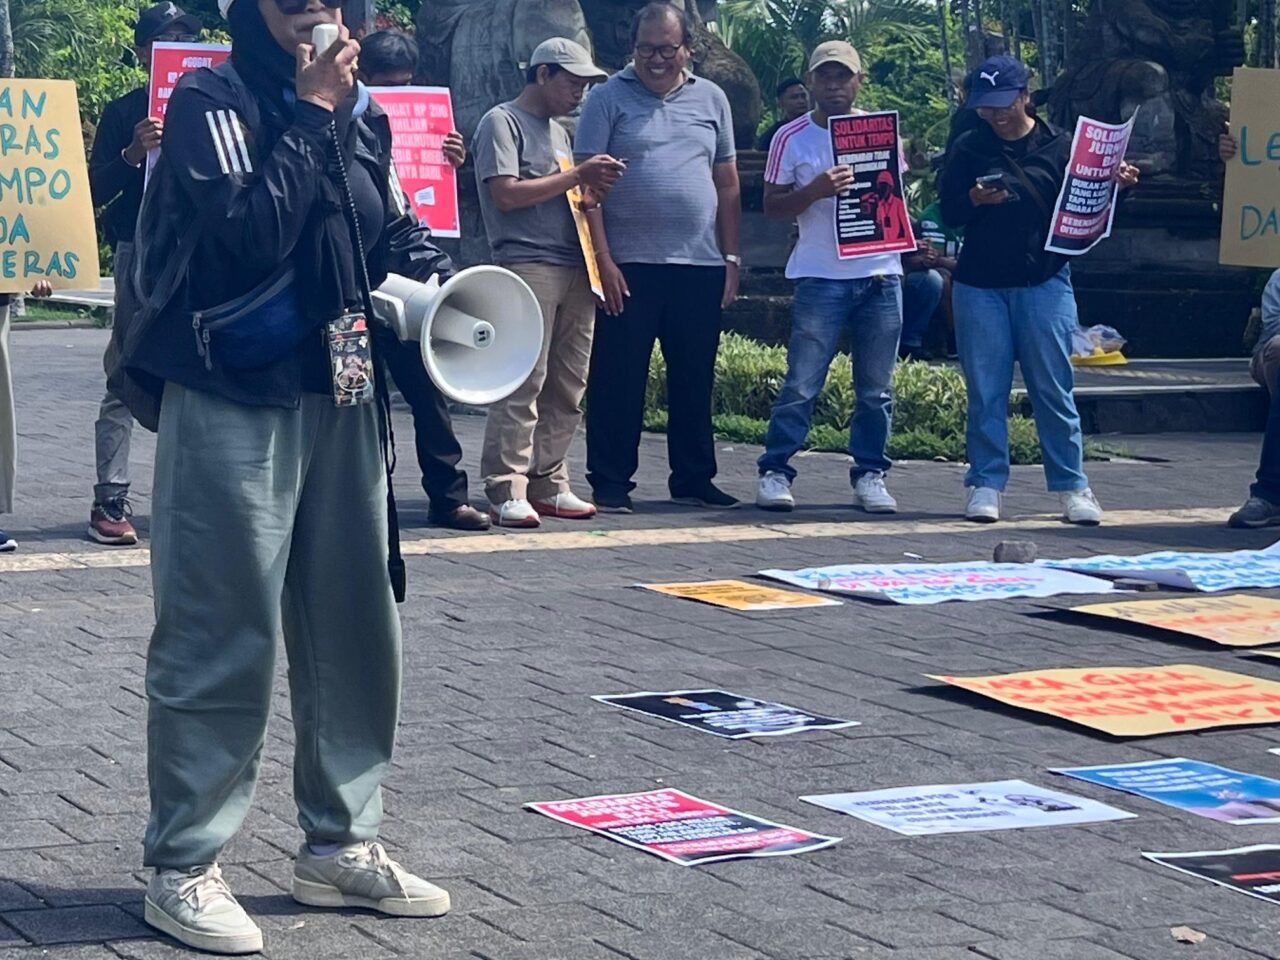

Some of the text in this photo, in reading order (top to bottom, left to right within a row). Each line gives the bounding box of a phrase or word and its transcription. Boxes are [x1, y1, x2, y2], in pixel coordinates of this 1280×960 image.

[833, 117, 894, 135] SOLIDARITAS
[835, 131, 895, 149] UNTUK TEMPO
[1240, 126, 1280, 166] LE
